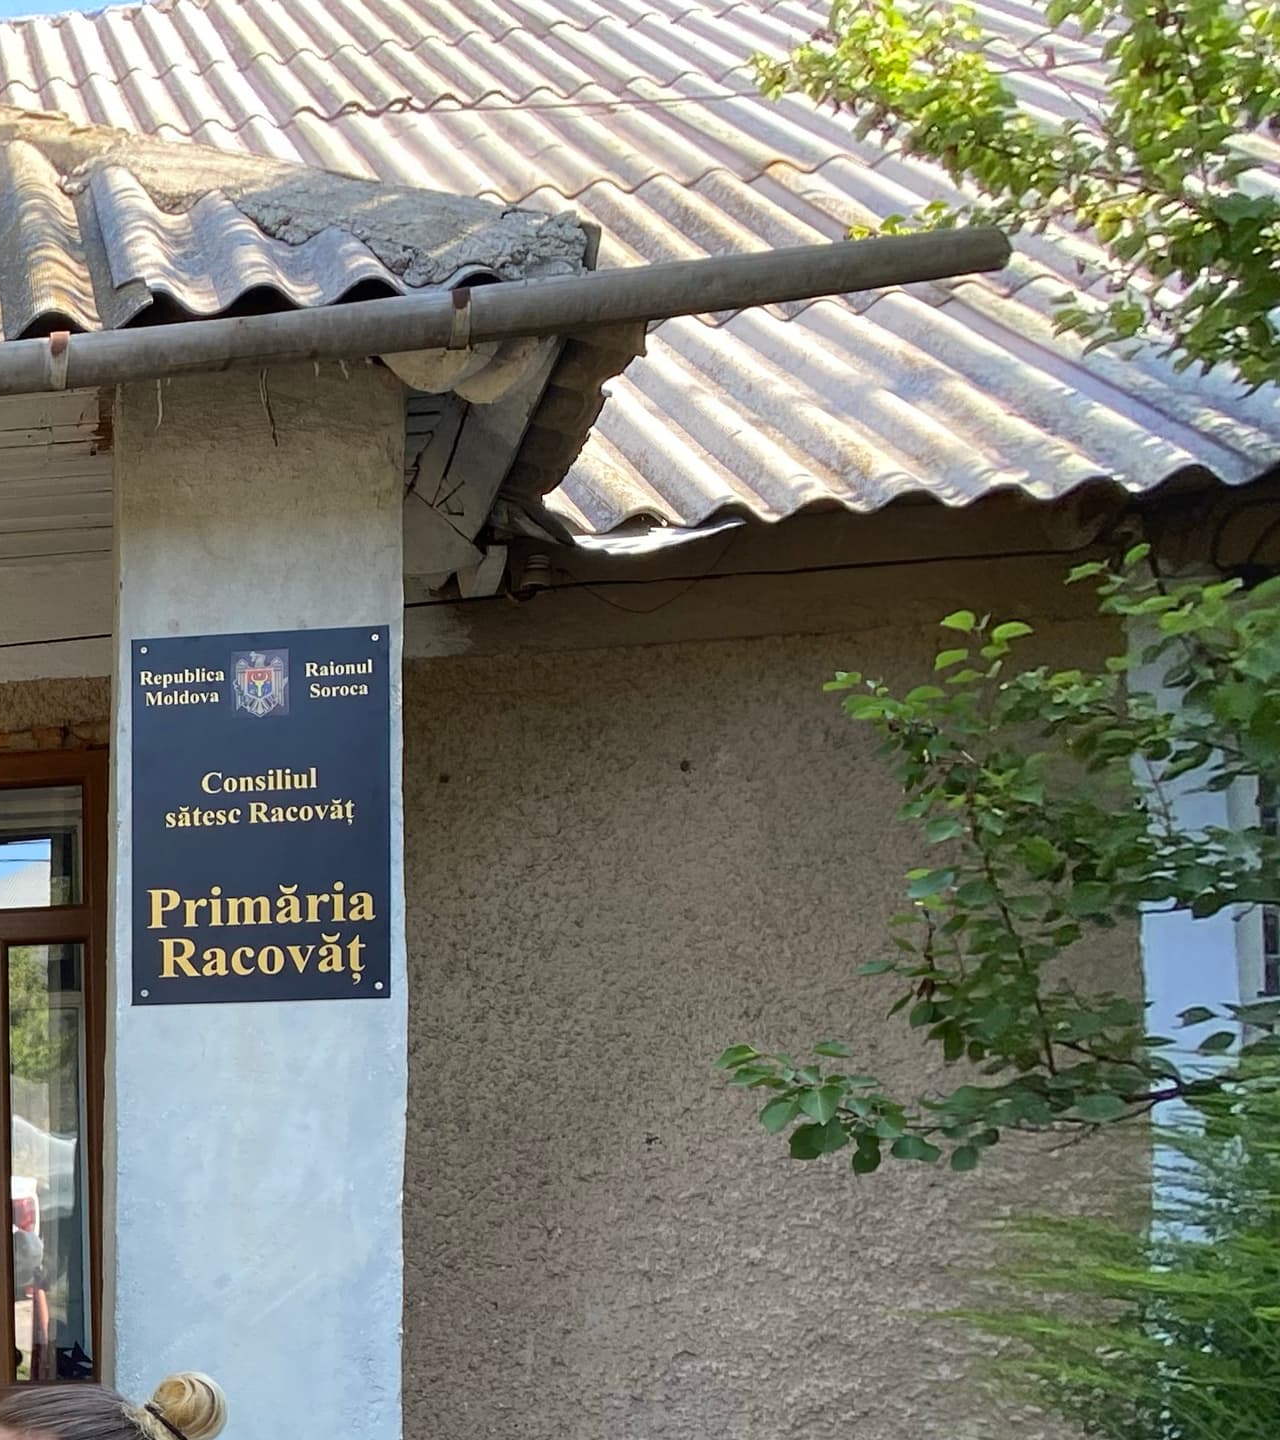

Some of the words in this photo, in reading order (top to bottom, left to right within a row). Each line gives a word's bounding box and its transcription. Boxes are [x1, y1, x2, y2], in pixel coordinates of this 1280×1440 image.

[140, 668, 225, 688] Republica
[305, 659, 373, 677] Raionul
[145, 690, 219, 707] Moldova
[309, 682, 368, 698] Soroca
[201, 767, 317, 794] Consiliul
[165, 806, 242, 828] sătesc
[248, 798, 355, 826] Racovăț
[146, 880, 376, 929] Primăria
[158, 932, 366, 985] Racovăț
